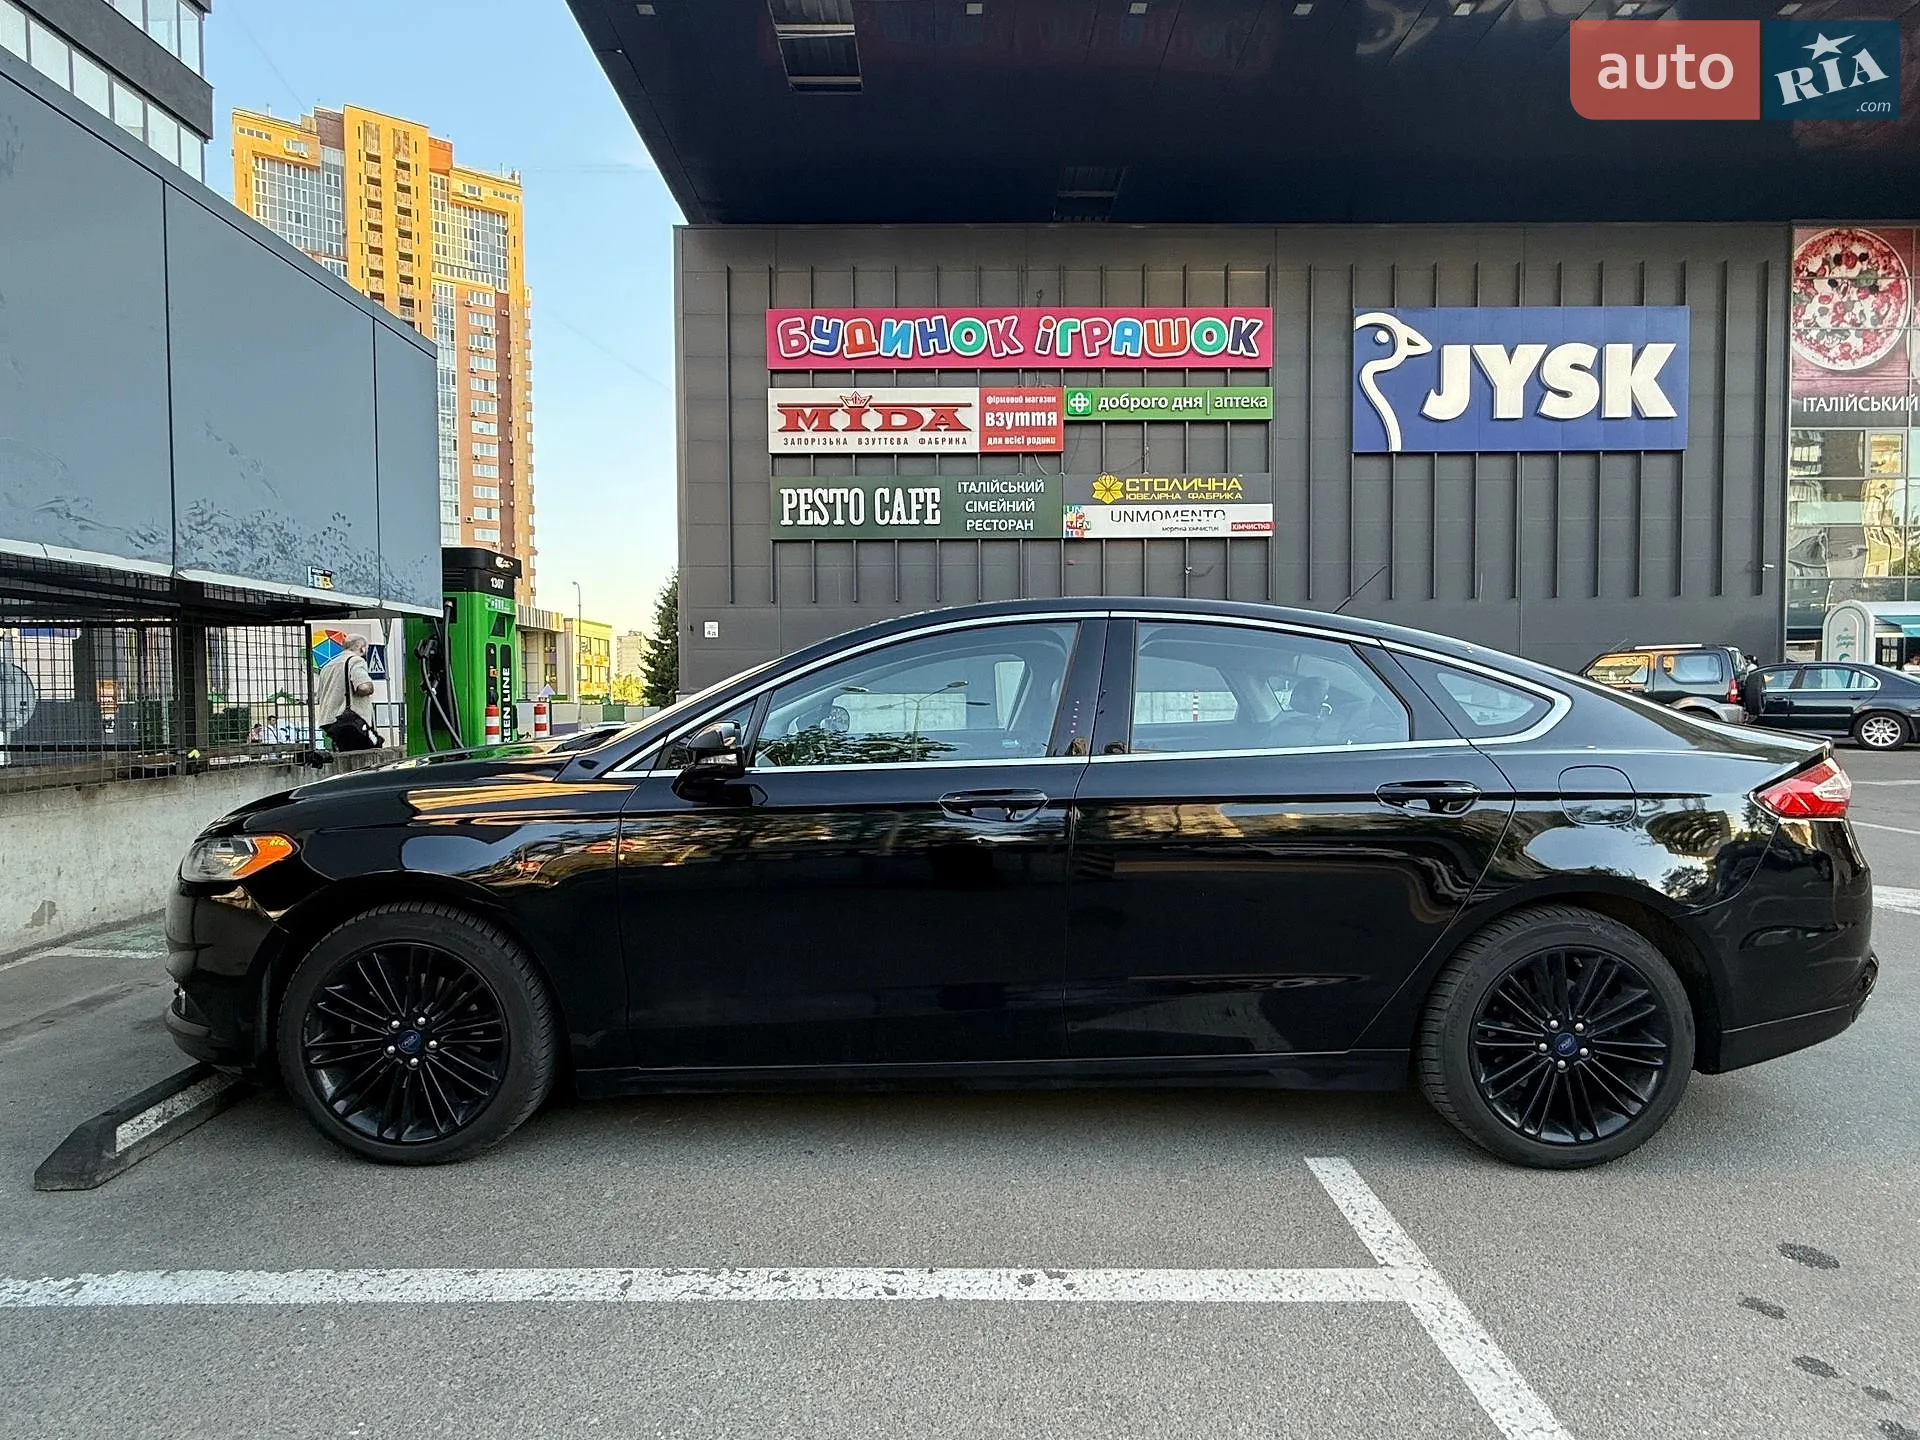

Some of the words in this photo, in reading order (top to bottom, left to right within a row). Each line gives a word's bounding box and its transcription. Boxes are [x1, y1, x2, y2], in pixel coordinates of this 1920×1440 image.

[776, 315, 1024, 359] БУДИНОК
[1421, 343, 1677, 420] JYSK
[1098, 393, 1168, 412] доброго
[1171, 396, 1203, 411] дня
[1214, 395, 1268, 409] аптека
[1803, 393, 1919, 412] ІТАЛІЙСЬКИЙ
[985, 411, 1057, 430] взуття
[783, 437, 848, 446] ЗАПОРІЗЬКА
[857, 437, 909, 446] ВЗУТТЄВА
[919, 437, 968, 446] ФАБРИКА
[987, 436, 1003, 446] для
[957, 480, 1045, 494] ІТАЛІЙСЬКИЙ
[1125, 477, 1243, 491] СТОЛИЧНА
[779, 487, 865, 526] PESTO
[874, 487, 941, 526] CAFE
[964, 498, 1036, 513] СІМЕЙНИЙ
[1111, 509, 1226, 522] UNMOMENTO
[966, 519, 1034, 531] РЕСТОРАН
[502, 667, 510, 702] LINE
